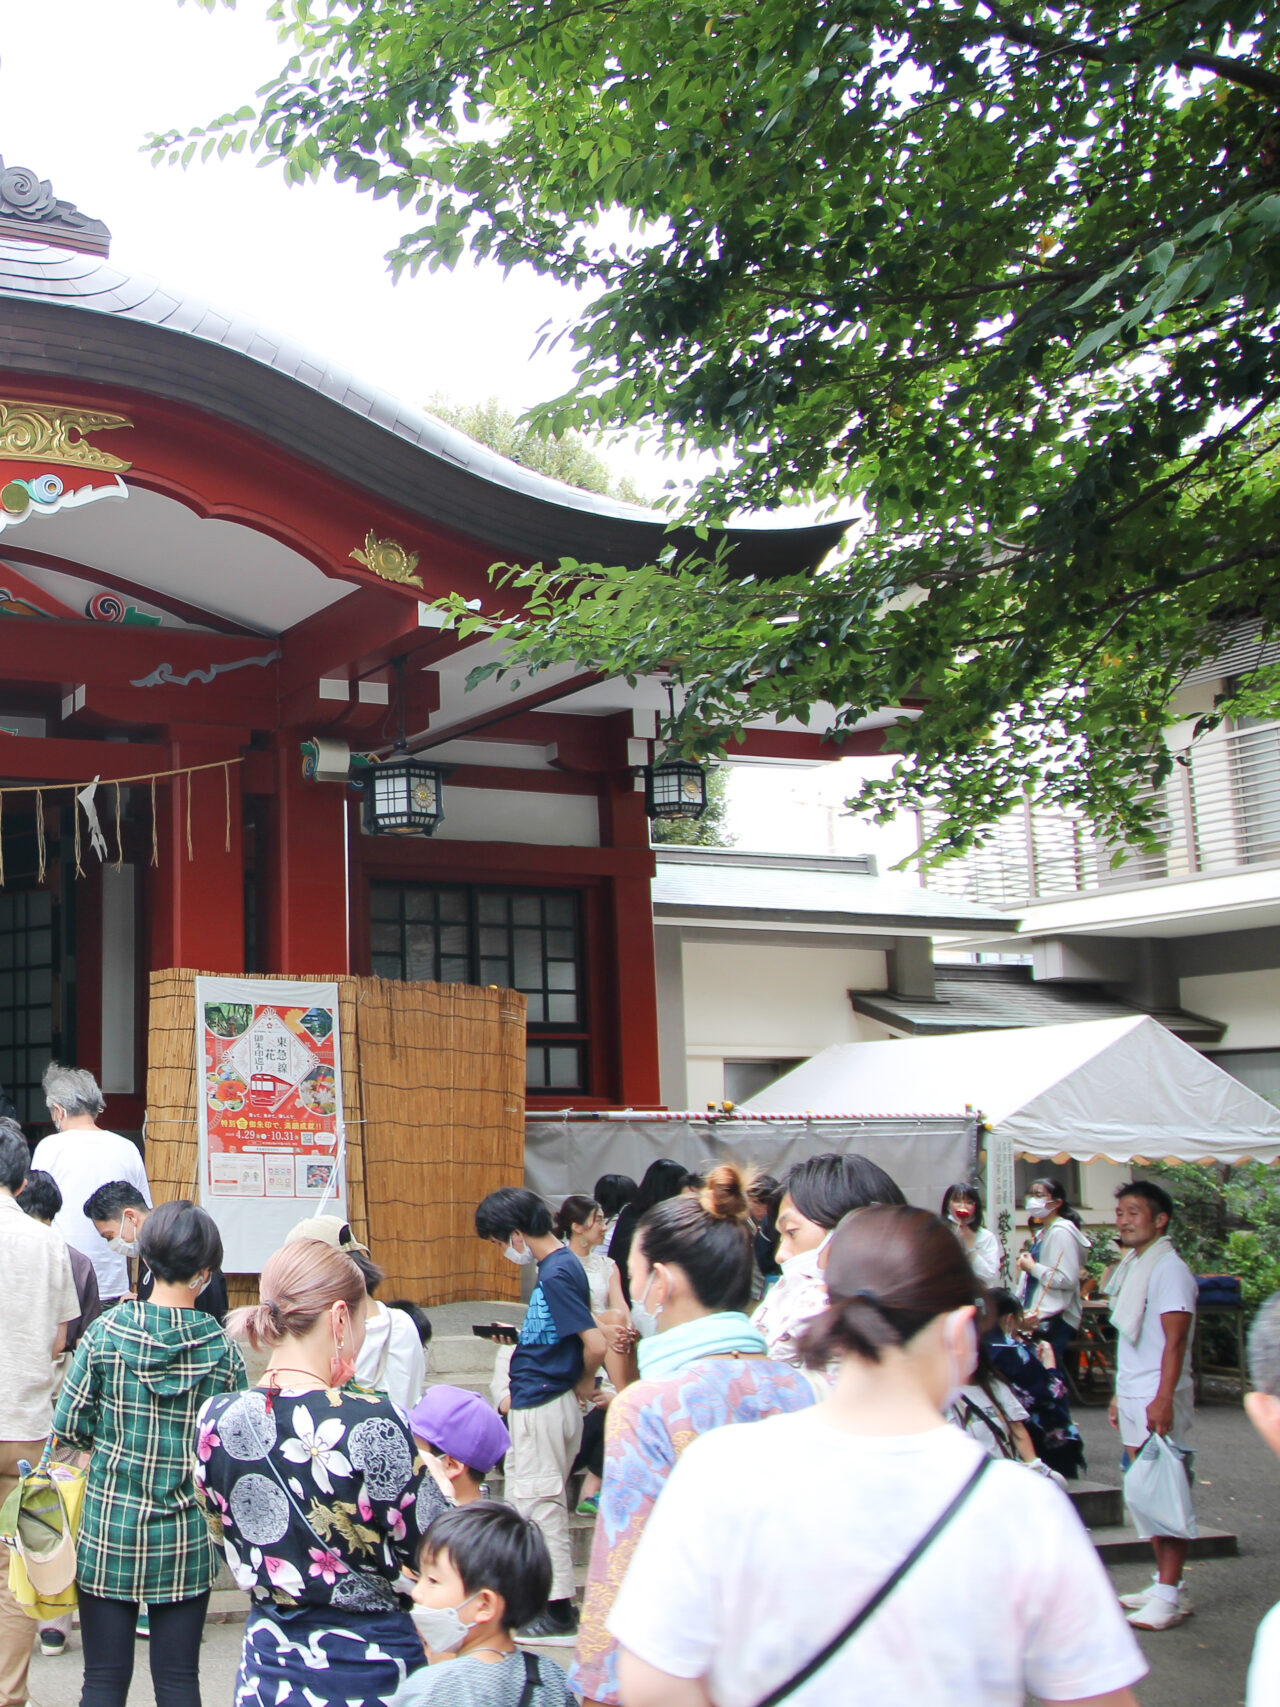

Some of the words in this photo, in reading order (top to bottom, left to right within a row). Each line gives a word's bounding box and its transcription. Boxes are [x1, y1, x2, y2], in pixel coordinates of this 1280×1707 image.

[254, 1034, 265, 1072] 御朱印巡り
[265, 1049, 276, 1061] 花
[277, 1036, 287, 1073] 東急線
[236, 1130, 256, 1140] 4.29
[272, 1131, 294, 1141] 10.31
